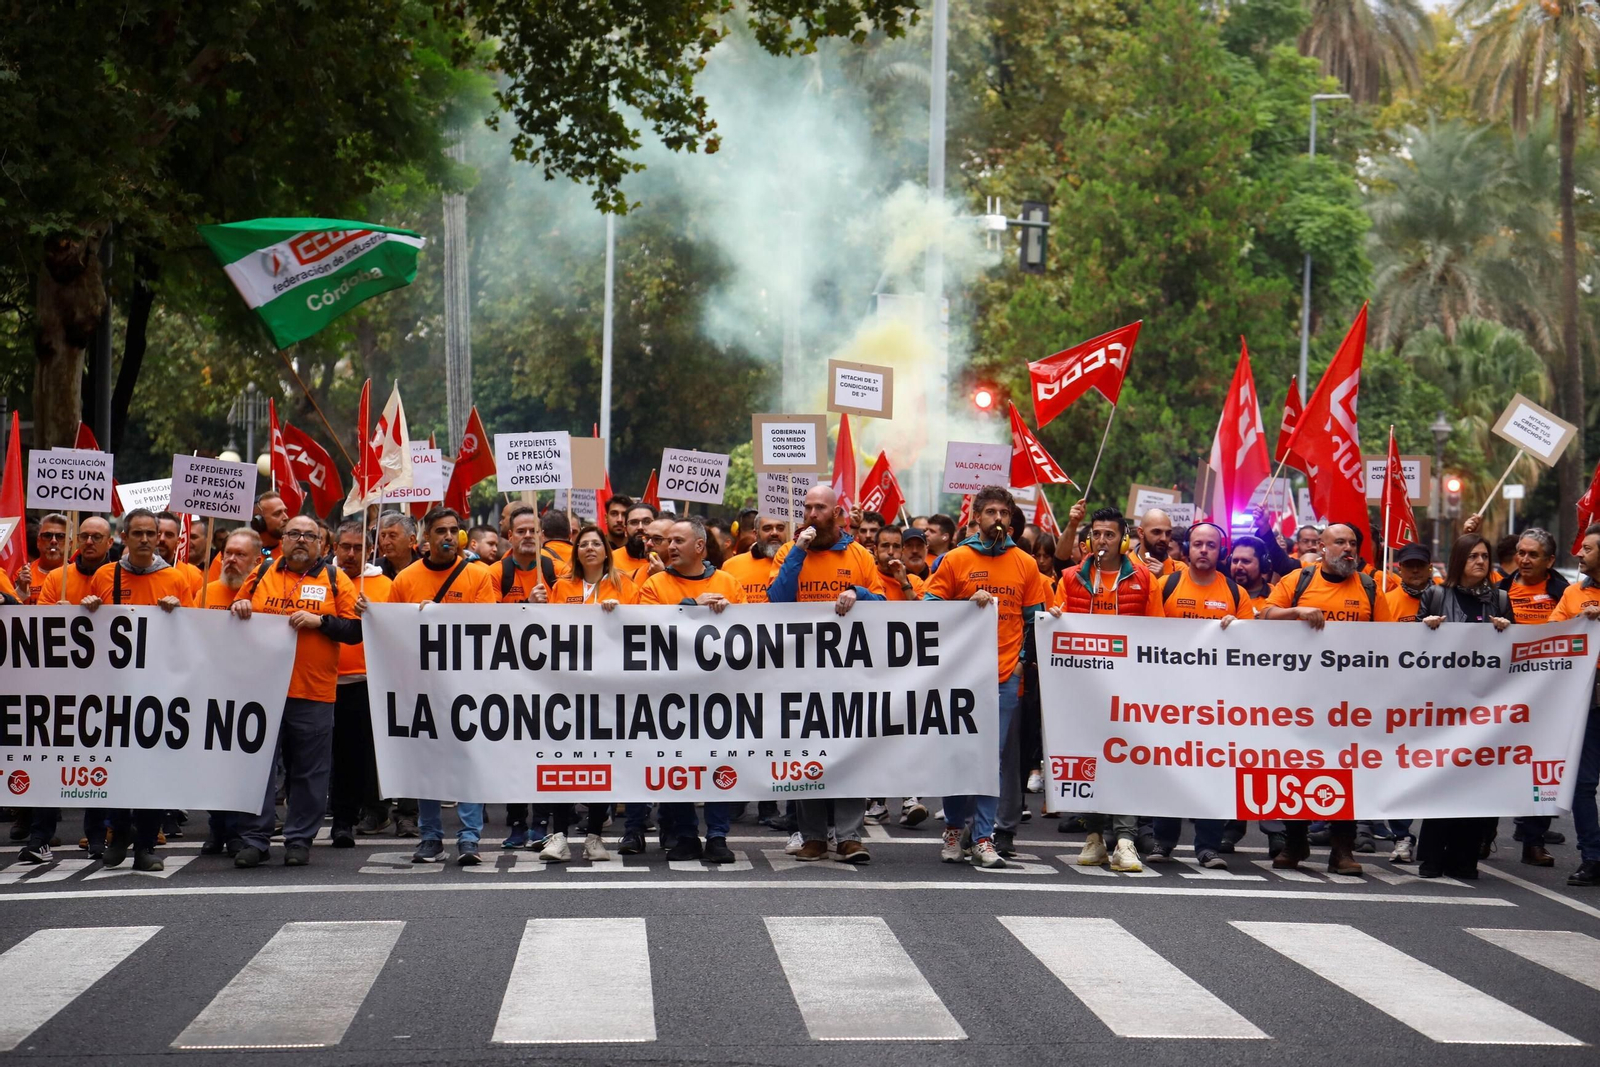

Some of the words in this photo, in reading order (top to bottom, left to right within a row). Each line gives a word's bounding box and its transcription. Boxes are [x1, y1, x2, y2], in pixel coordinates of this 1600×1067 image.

[272, 263, 332, 294] federación
[332, 255, 345, 268] de
[344, 232, 388, 260] industria
[306, 266, 384, 312] Córdoba
[841, 374, 863, 382] HITACHI
[840, 382, 878, 392] CONDICIONES
[1520, 418, 1539, 432] CRECE
[1540, 428, 1550, 438] TUS
[1528, 415, 1550, 430] HITACHI
[1513, 420, 1542, 441] DERECHOS
[1542, 438, 1551, 446] NO
[509, 438, 557, 448] EXPEDIENTES
[411, 454, 437, 464] CIAL
[507, 451, 519, 461] DE
[522, 448, 561, 460] PRESIÓN
[678, 455, 723, 466] CONCILIACIÓN
[49, 457, 106, 467] CONCILIACIÓN
[516, 463, 533, 474] ¡NO
[534, 460, 553, 471] MÁS
[955, 461, 1002, 471] VALORACIÓN
[37, 468, 57, 480] NO
[61, 469, 74, 480] ES
[78, 470, 106, 482] UNA
[189, 463, 243, 477] EXPEDIENTES
[668, 464, 685, 474] NO
[687, 466, 698, 476] ES
[700, 467, 721, 478] UNA
[184, 474, 198, 484] DE
[201, 476, 245, 490] PRESIÓN
[510, 474, 561, 485] OPRESIÓN!
[766, 473, 809, 486] INVERSONES
[36, 483, 105, 502] OPCIÓN
[129, 485, 171, 496] INVERSION
[192, 488, 211, 498] ¡NO
[213, 488, 234, 500] MÁS
[386, 488, 431, 498] DESPIDO
[665, 478, 720, 496] OPCIÓN
[144, 494, 170, 503] PRIME
[184, 499, 241, 514] OPRESIÓN!
[778, 508, 803, 518] TERER
[303, 586, 324, 594] USO
[742, 584, 766, 593] HITA
[976, 584, 1016, 596] Hitachi
[265, 596, 320, 610] HITACHI
[1322, 610, 1359, 621] TACHI
[0, 616, 95, 668] NES
[108, 616, 148, 669] SI
[420, 624, 592, 671] HITACHI
[623, 624, 678, 671] EN
[694, 621, 873, 671] CONTRA
[887, 621, 939, 667] DE
[1056, 636, 1109, 652] CCOO
[1515, 639, 1569, 659] CCOO
[1050, 654, 1114, 670] industria
[1137, 646, 1218, 666] Hitachi
[1226, 649, 1312, 672] Energy
[1320, 650, 1389, 672] Spain
[1398, 651, 1501, 669] Córdoba
[1508, 659, 1572, 673] industria
[387, 691, 438, 739] LA
[451, 693, 763, 742] CONCILIACION
[780, 688, 978, 739] FAMILIAR
[1110, 695, 1314, 727] Inversiones
[1327, 701, 1372, 727] de
[1386, 702, 1530, 733] primera
[204, 698, 267, 754] NO
[7, 754, 112, 762] EMPRESA
[536, 750, 633, 758] COMITE
[657, 750, 682, 758] DE
[1103, 737, 1325, 769] Condiciones
[1338, 743, 1383, 769] de
[1396, 742, 1533, 768] tercera
[61, 766, 108, 786] USO
[771, 760, 824, 781] USO
[542, 771, 607, 785] CCOO
[645, 766, 707, 791] UGT
[61, 786, 108, 799] industria
[772, 781, 825, 792] industria
[1243, 774, 1346, 816] USO
